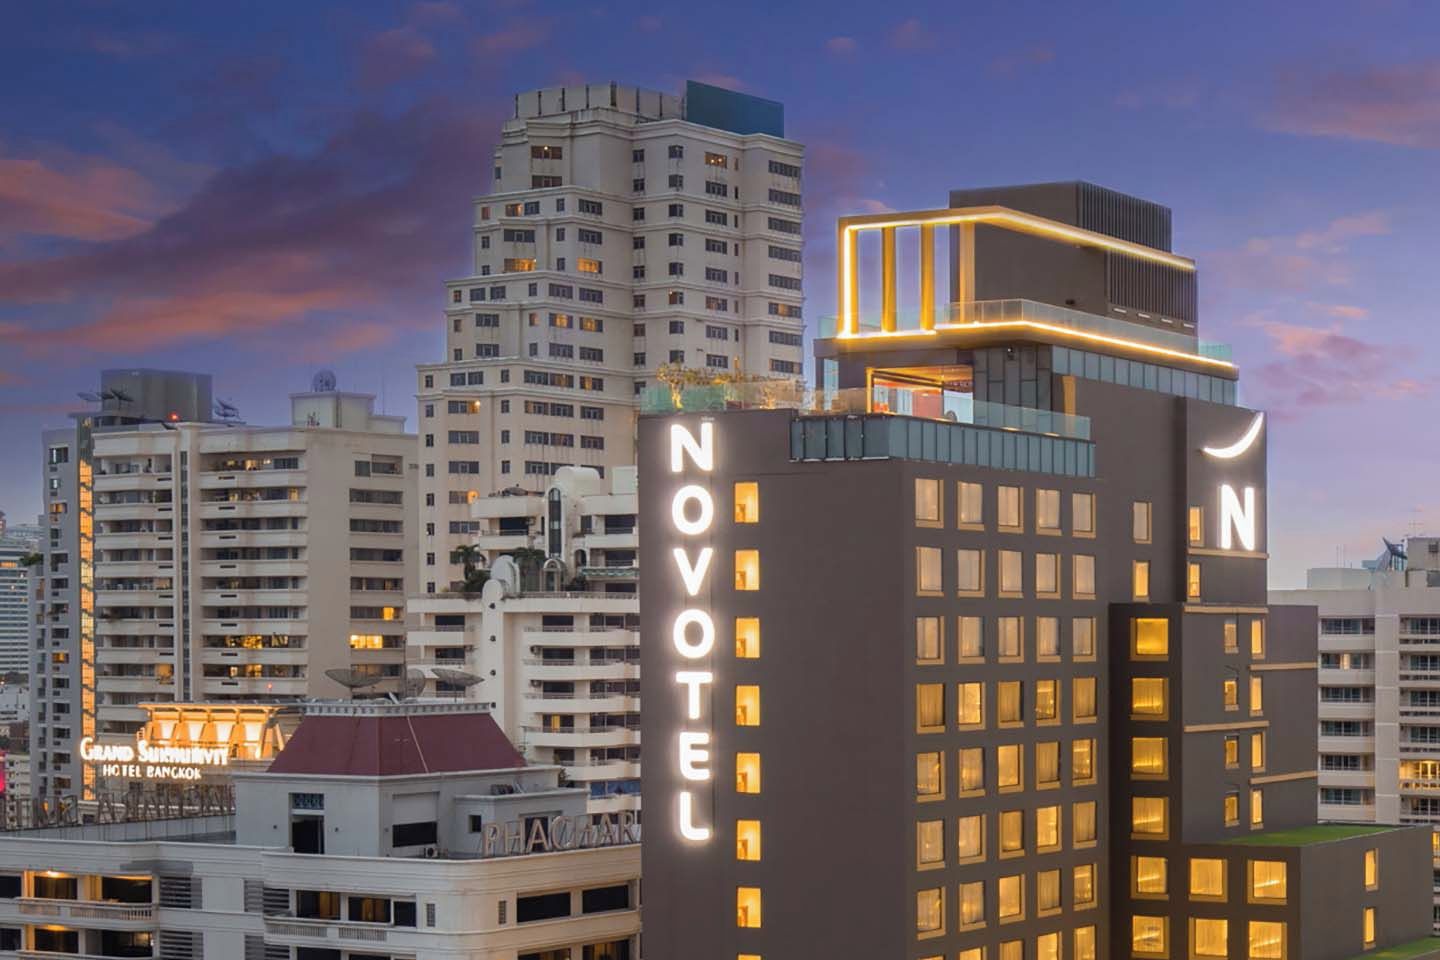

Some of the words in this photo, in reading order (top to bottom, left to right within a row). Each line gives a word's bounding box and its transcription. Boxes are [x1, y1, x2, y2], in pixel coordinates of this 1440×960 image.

[1220, 484, 1256, 551] N
[670, 421, 715, 841] NOVOTEL
[102, 764, 142, 778] HOTEL
[146, 766, 202, 780] BANGKOK
